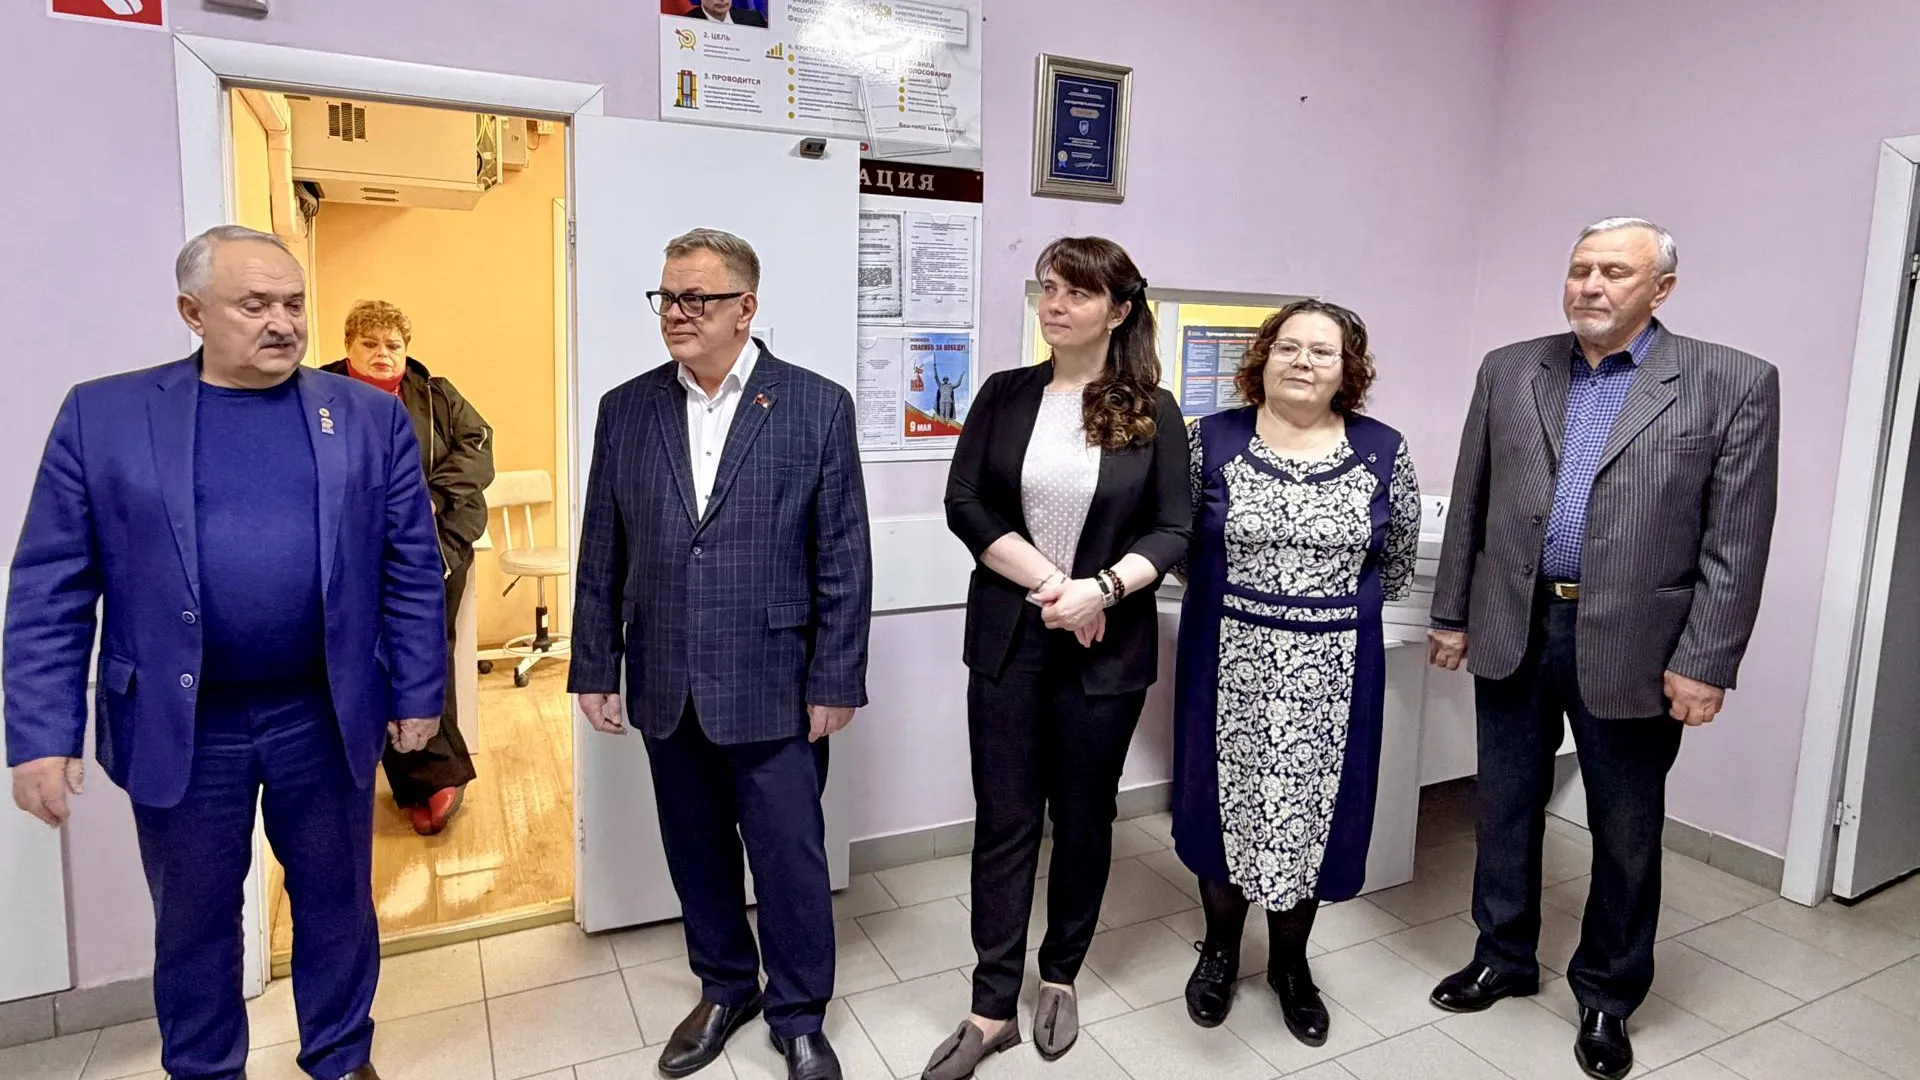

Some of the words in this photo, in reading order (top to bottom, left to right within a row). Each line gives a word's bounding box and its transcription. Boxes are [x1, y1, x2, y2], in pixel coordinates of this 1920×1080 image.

[711, 32, 731, 41] ЦЕЛЬ
[703, 72, 710, 81] 3.
[711, 74, 761, 86] ПРОВОДИТСЯ
[910, 343, 934, 351] СПАСИБО
[909, 421, 916, 432] 9
[917, 423, 932, 432] МАЯ
